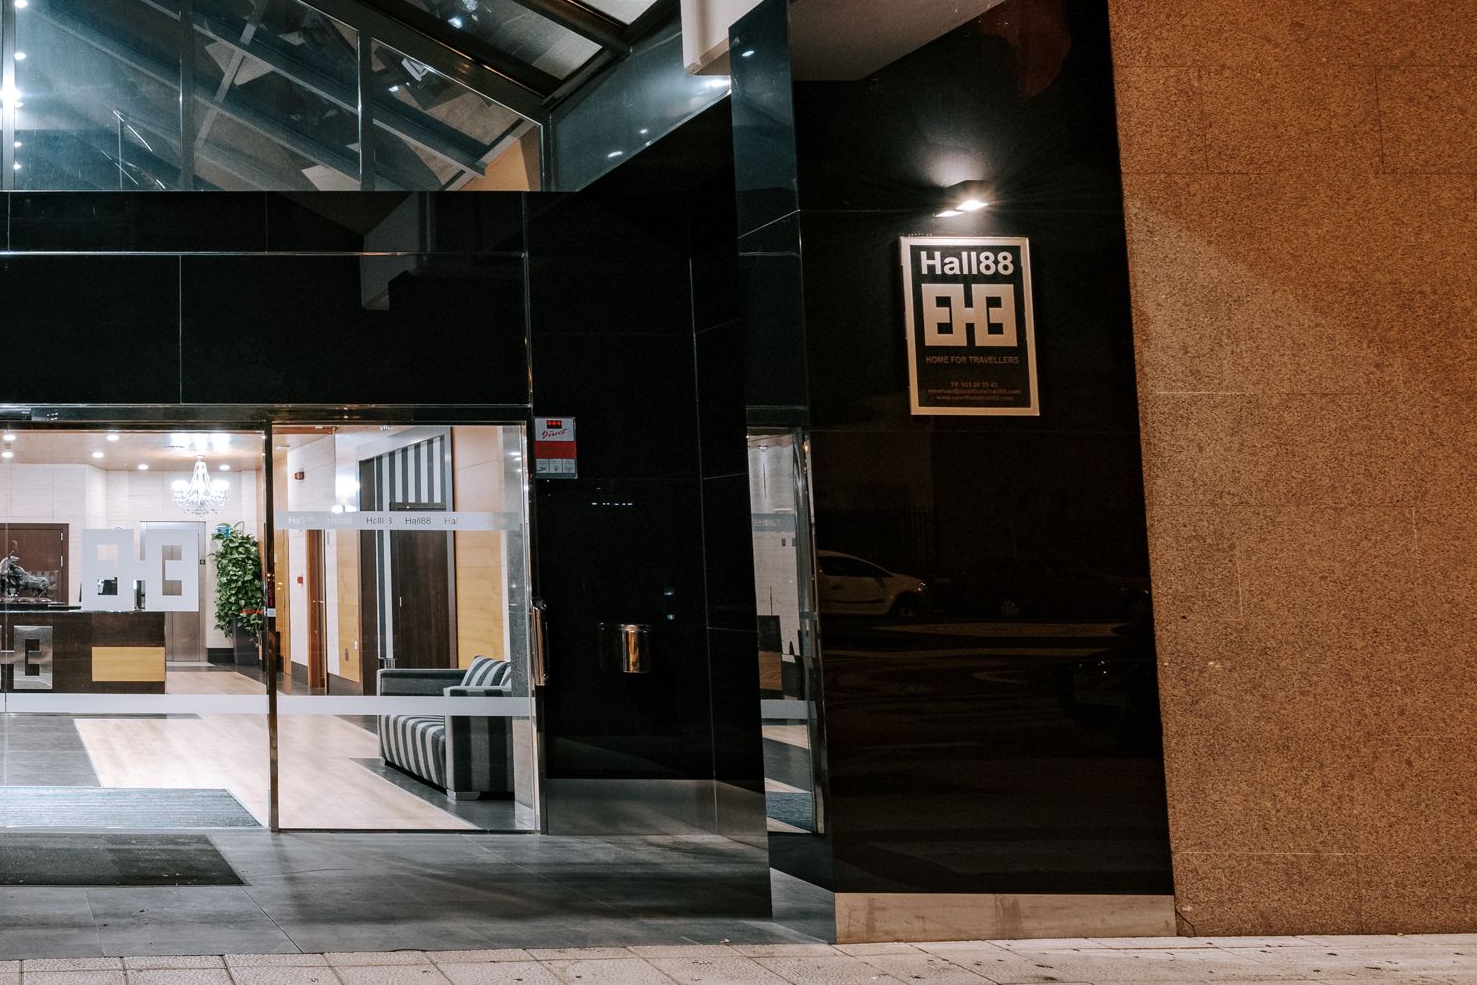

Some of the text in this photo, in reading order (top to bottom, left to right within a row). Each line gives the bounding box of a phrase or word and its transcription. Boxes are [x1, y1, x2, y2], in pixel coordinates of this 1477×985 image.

[920, 251, 1014, 275] Hall88
[926, 356, 1019, 364] HOME FOR TRAVELLERS
[405, 517, 432, 525] Hall88
